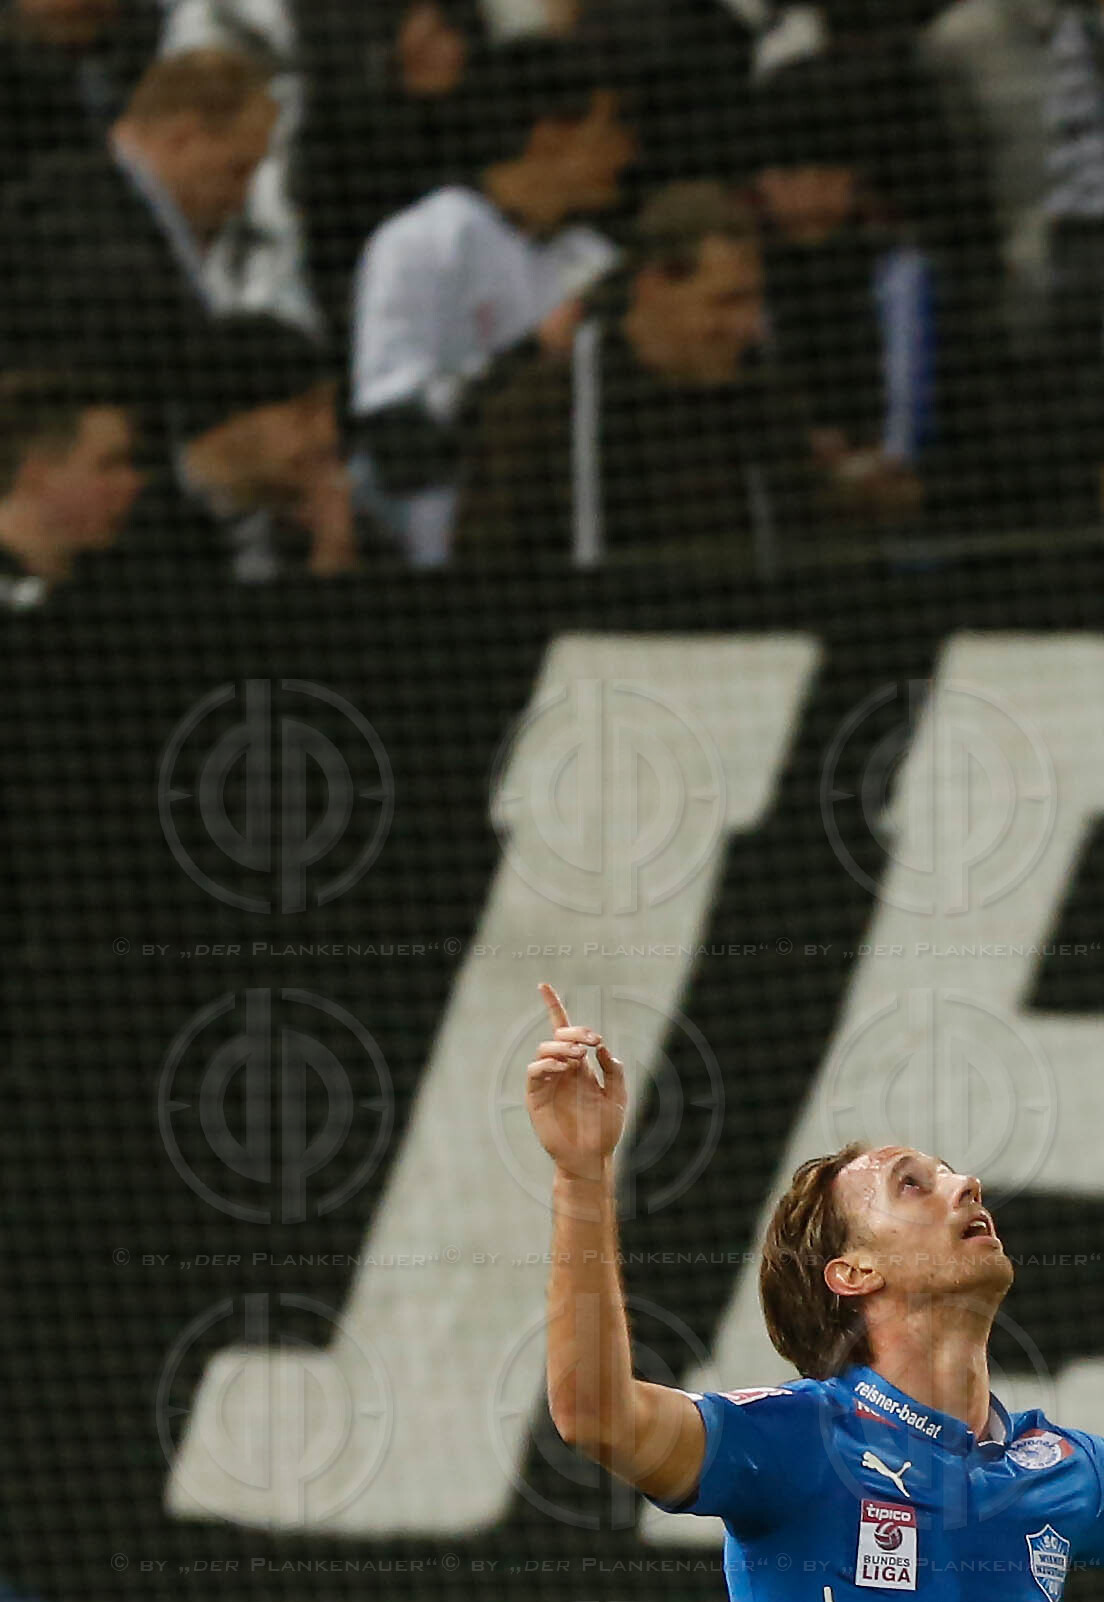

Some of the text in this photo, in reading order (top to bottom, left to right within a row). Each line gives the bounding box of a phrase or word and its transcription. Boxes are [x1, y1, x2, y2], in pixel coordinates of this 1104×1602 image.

[855, 1381, 942, 1439] reisner-bad.at
[866, 1503, 912, 1522] tipico
[863, 1555, 910, 1568] BUNDES
[862, 1565, 911, 1583] LIGA
